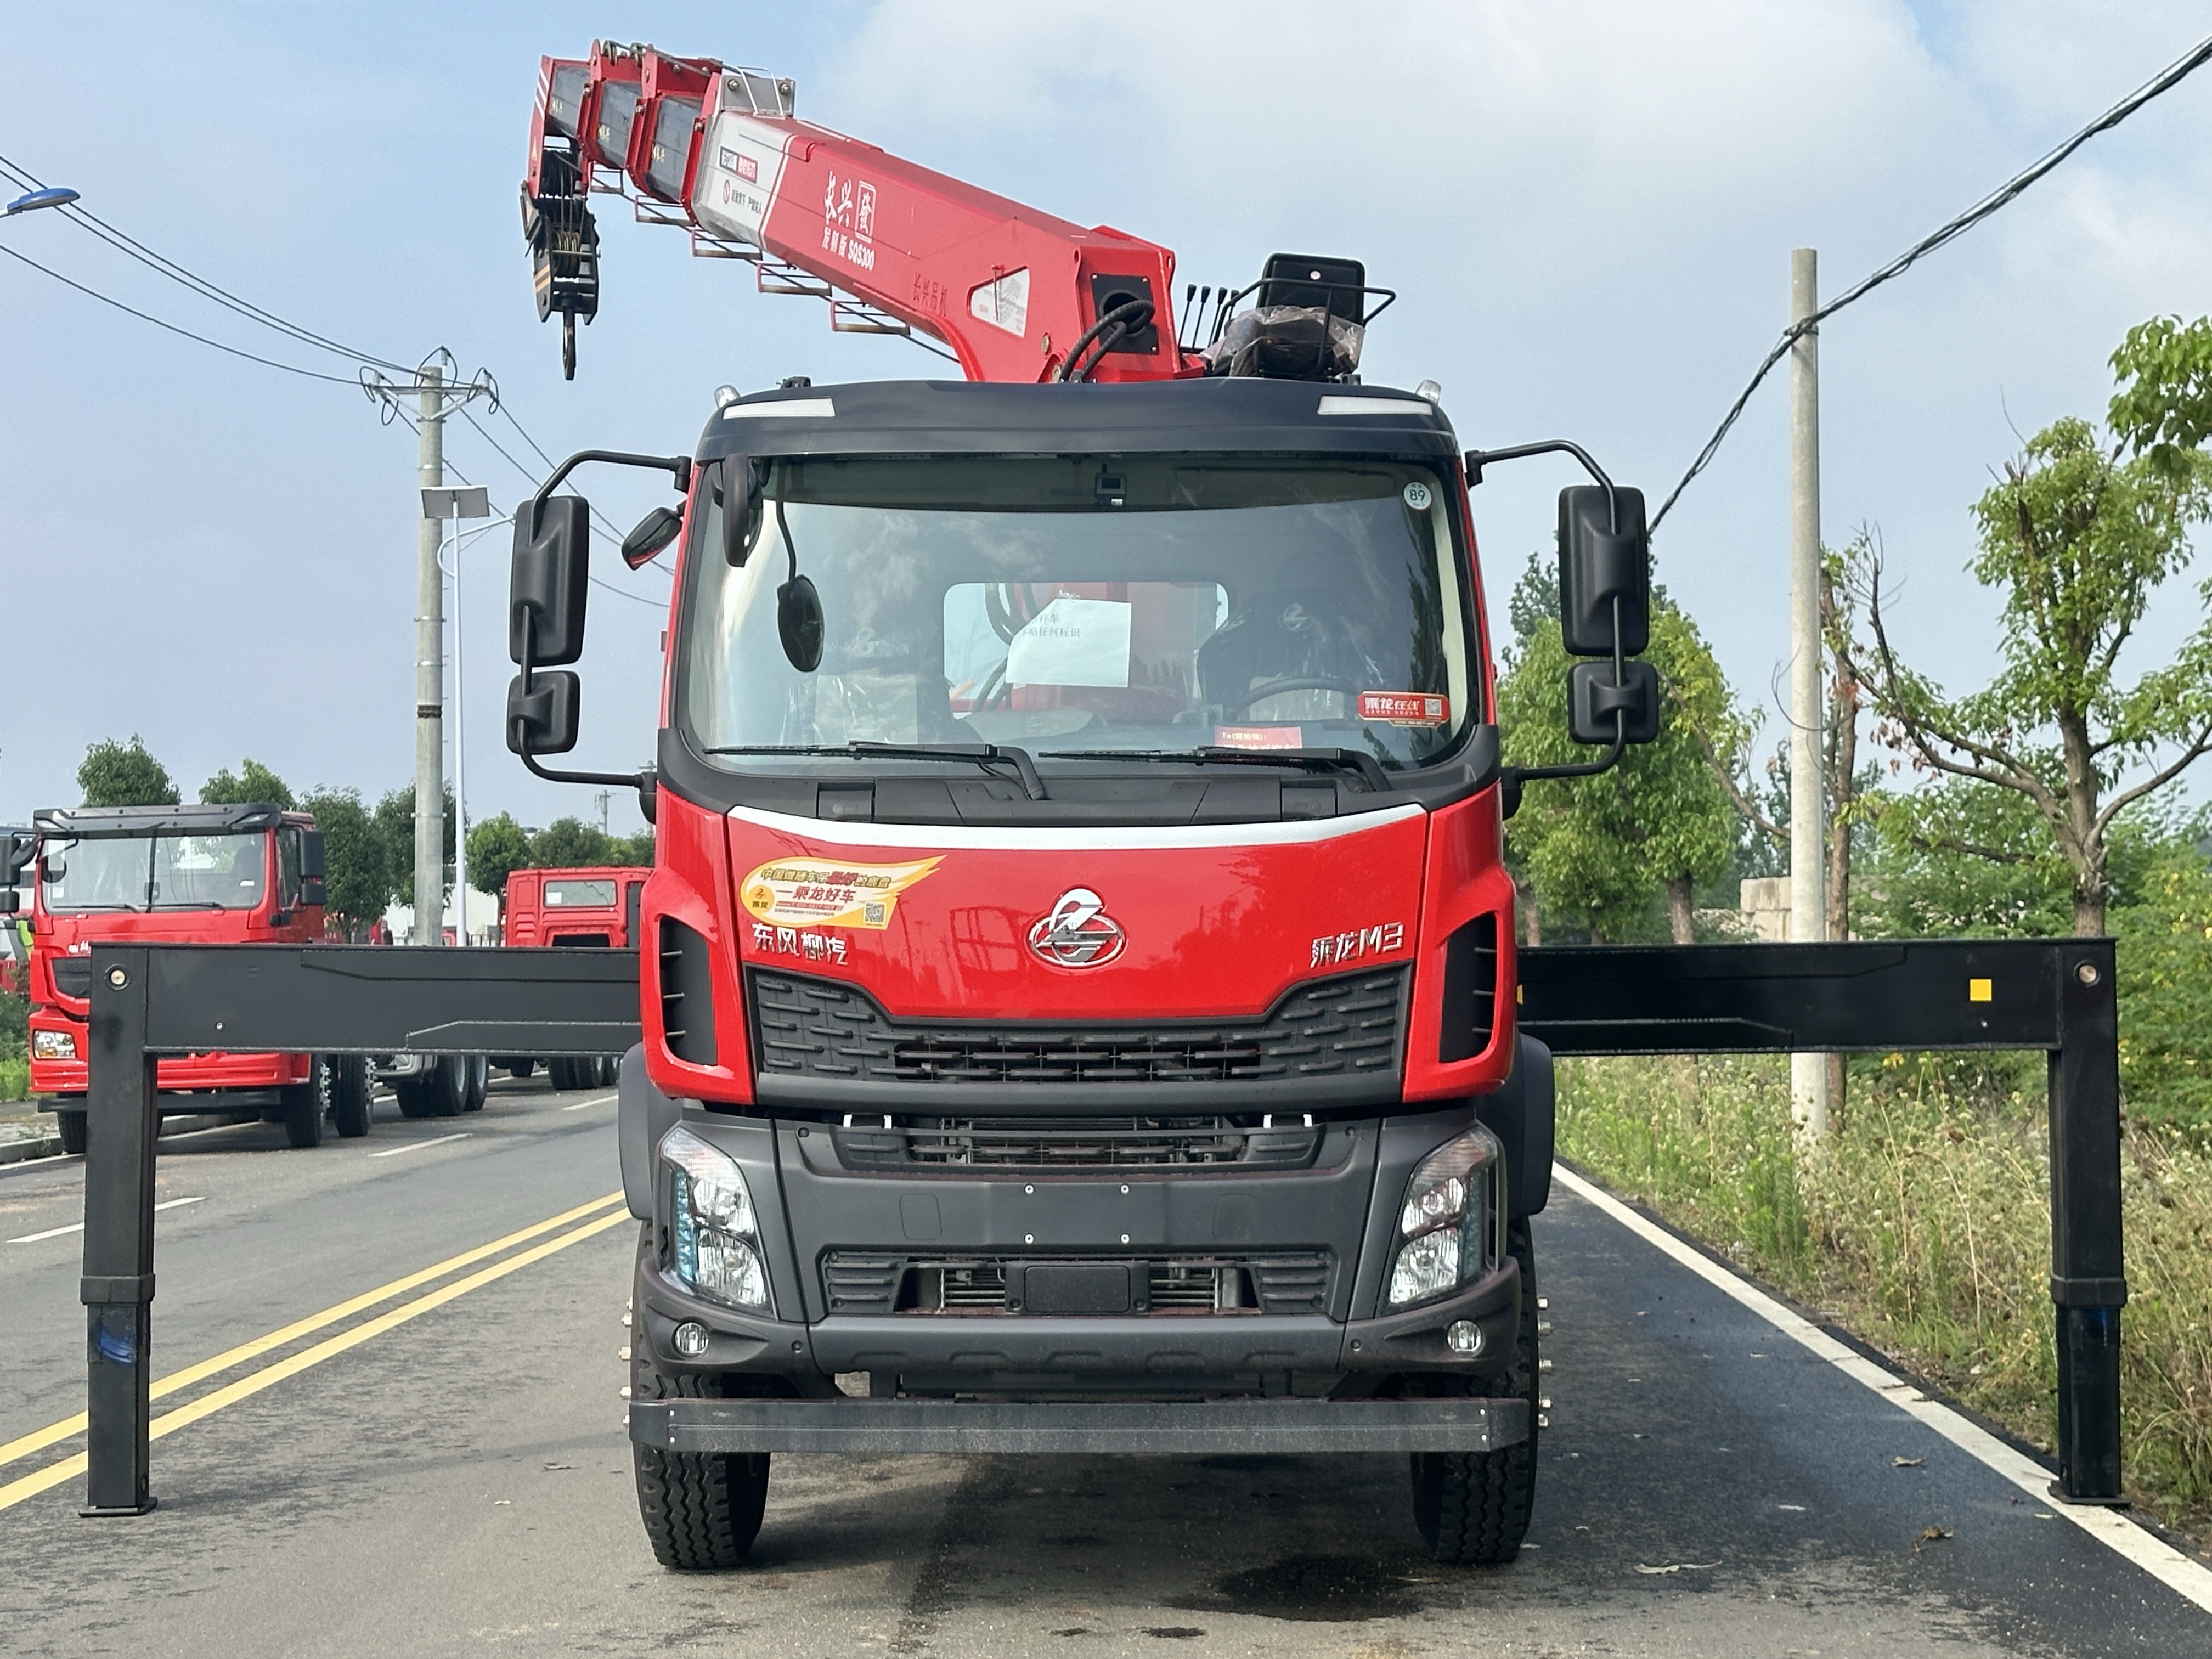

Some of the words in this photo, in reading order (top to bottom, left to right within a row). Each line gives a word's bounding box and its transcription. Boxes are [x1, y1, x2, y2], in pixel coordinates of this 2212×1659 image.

[848, 239, 875, 271] SQS300
[1409, 489, 1426, 501] 89
[752, 923, 849, 966] 东风柳汽
